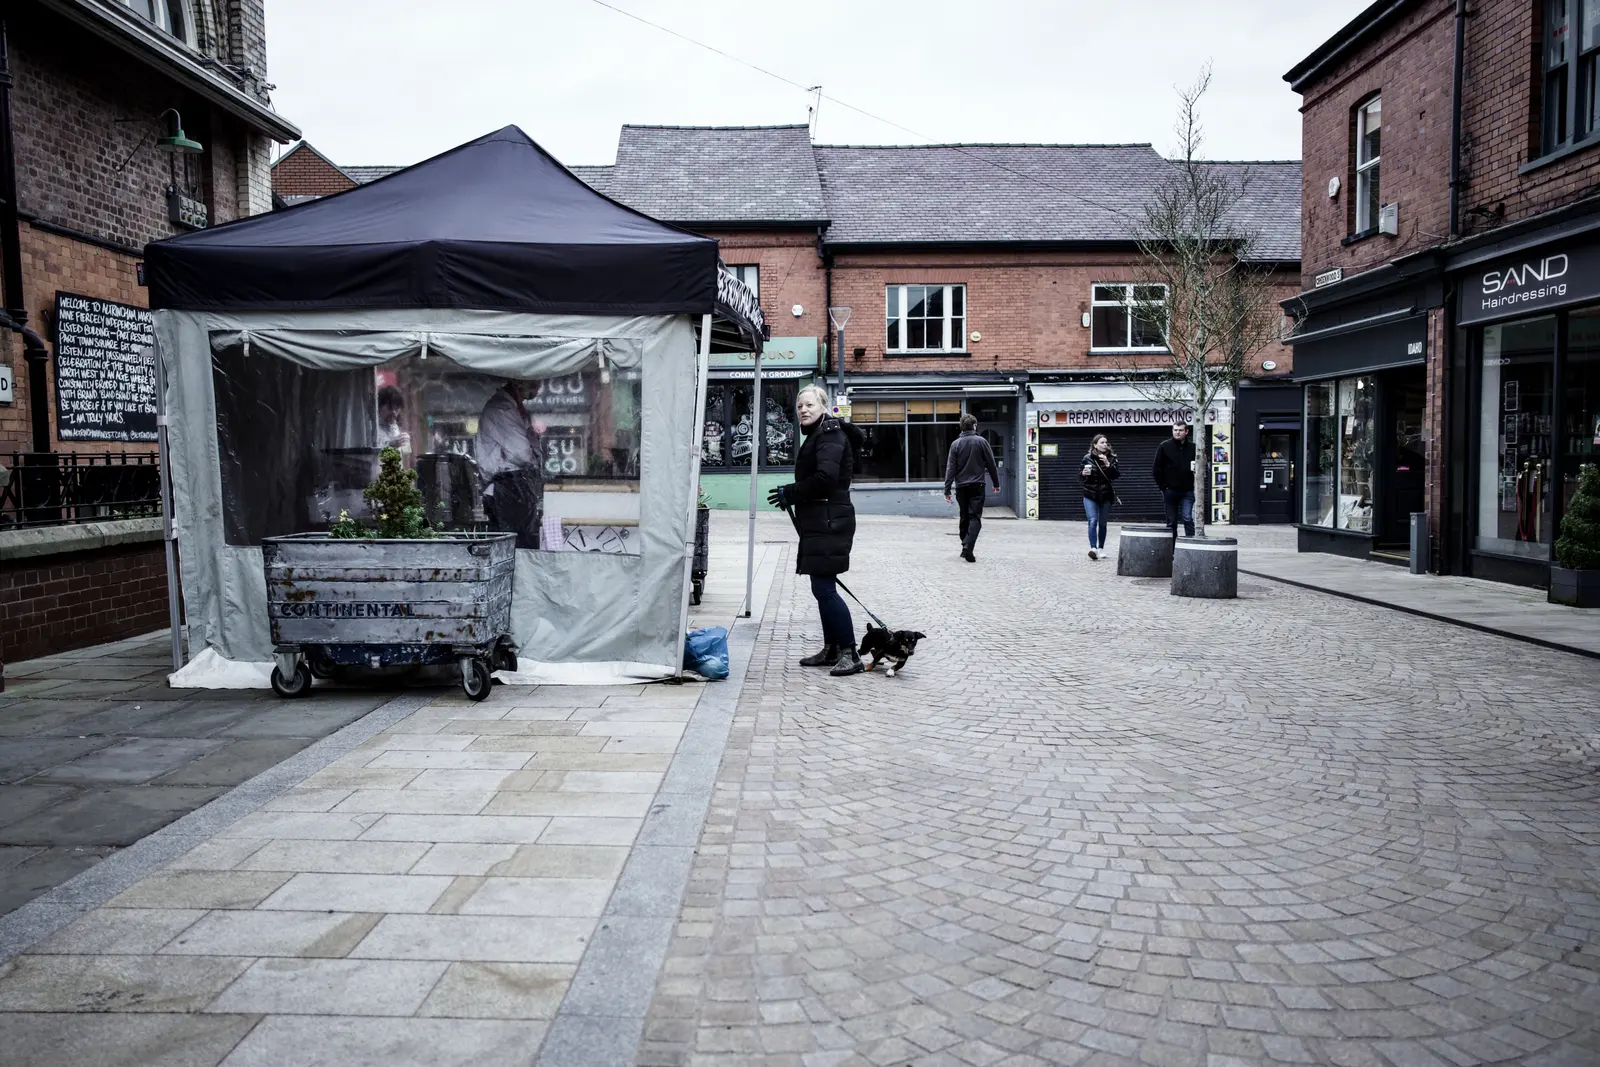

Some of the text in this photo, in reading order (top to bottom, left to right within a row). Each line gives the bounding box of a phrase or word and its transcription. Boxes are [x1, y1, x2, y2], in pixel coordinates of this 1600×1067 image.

[1482, 253, 1568, 294] SAND
[60, 297, 90, 312] WELCOME
[91, 301, 100, 312] TO
[1482, 283, 1567, 310] Hairdressing
[60, 309, 75, 321] NINE
[75, 311, 105, 328] FIERCELY
[105, 317, 143, 332] INDEPENDENT
[59, 321, 83, 333] LISTED
[84, 324, 110, 338] BUILDING
[116, 330, 131, 341] PART
[59, 332, 77, 345] PART
[77, 336, 94, 346] TOWN
[94, 338, 118, 350] SQUARE
[58, 355, 101, 369] CELEBRATION
[102, 361, 110, 370] OF
[111, 361, 124, 371] THE
[125, 364, 148, 376] IDENTITY
[105, 351, 142, 367] PASSIONATELY
[60, 367, 80, 379] NORTH
[81, 369, 98, 379] WEST
[100, 370, 106, 380] IN
[107, 370, 115, 380] AN
[116, 370, 129, 382] AGE
[130, 374, 149, 385] WHERE
[58, 377, 94, 392] CONSTANTLY
[95, 379, 118, 390] ERODED
[60, 389, 76, 399] WITH
[61, 399, 70, 410] BE
[70, 400, 100, 412] YOURSELF
[107, 400, 113, 410] IF
[113, 401, 124, 412] YOU
[124, 402, 137, 412] LIKE
[77, 412, 86, 423] AM
[86, 412, 103, 426] TRULY
[1069, 411, 1122, 424] REPAIRING
[1124, 411, 1132, 423] &
[1133, 411, 1193, 424] UNLOCKING
[548, 439, 574, 455] SU
[545, 457, 577, 472] GO
[281, 603, 415, 617] CONTINENTAL
